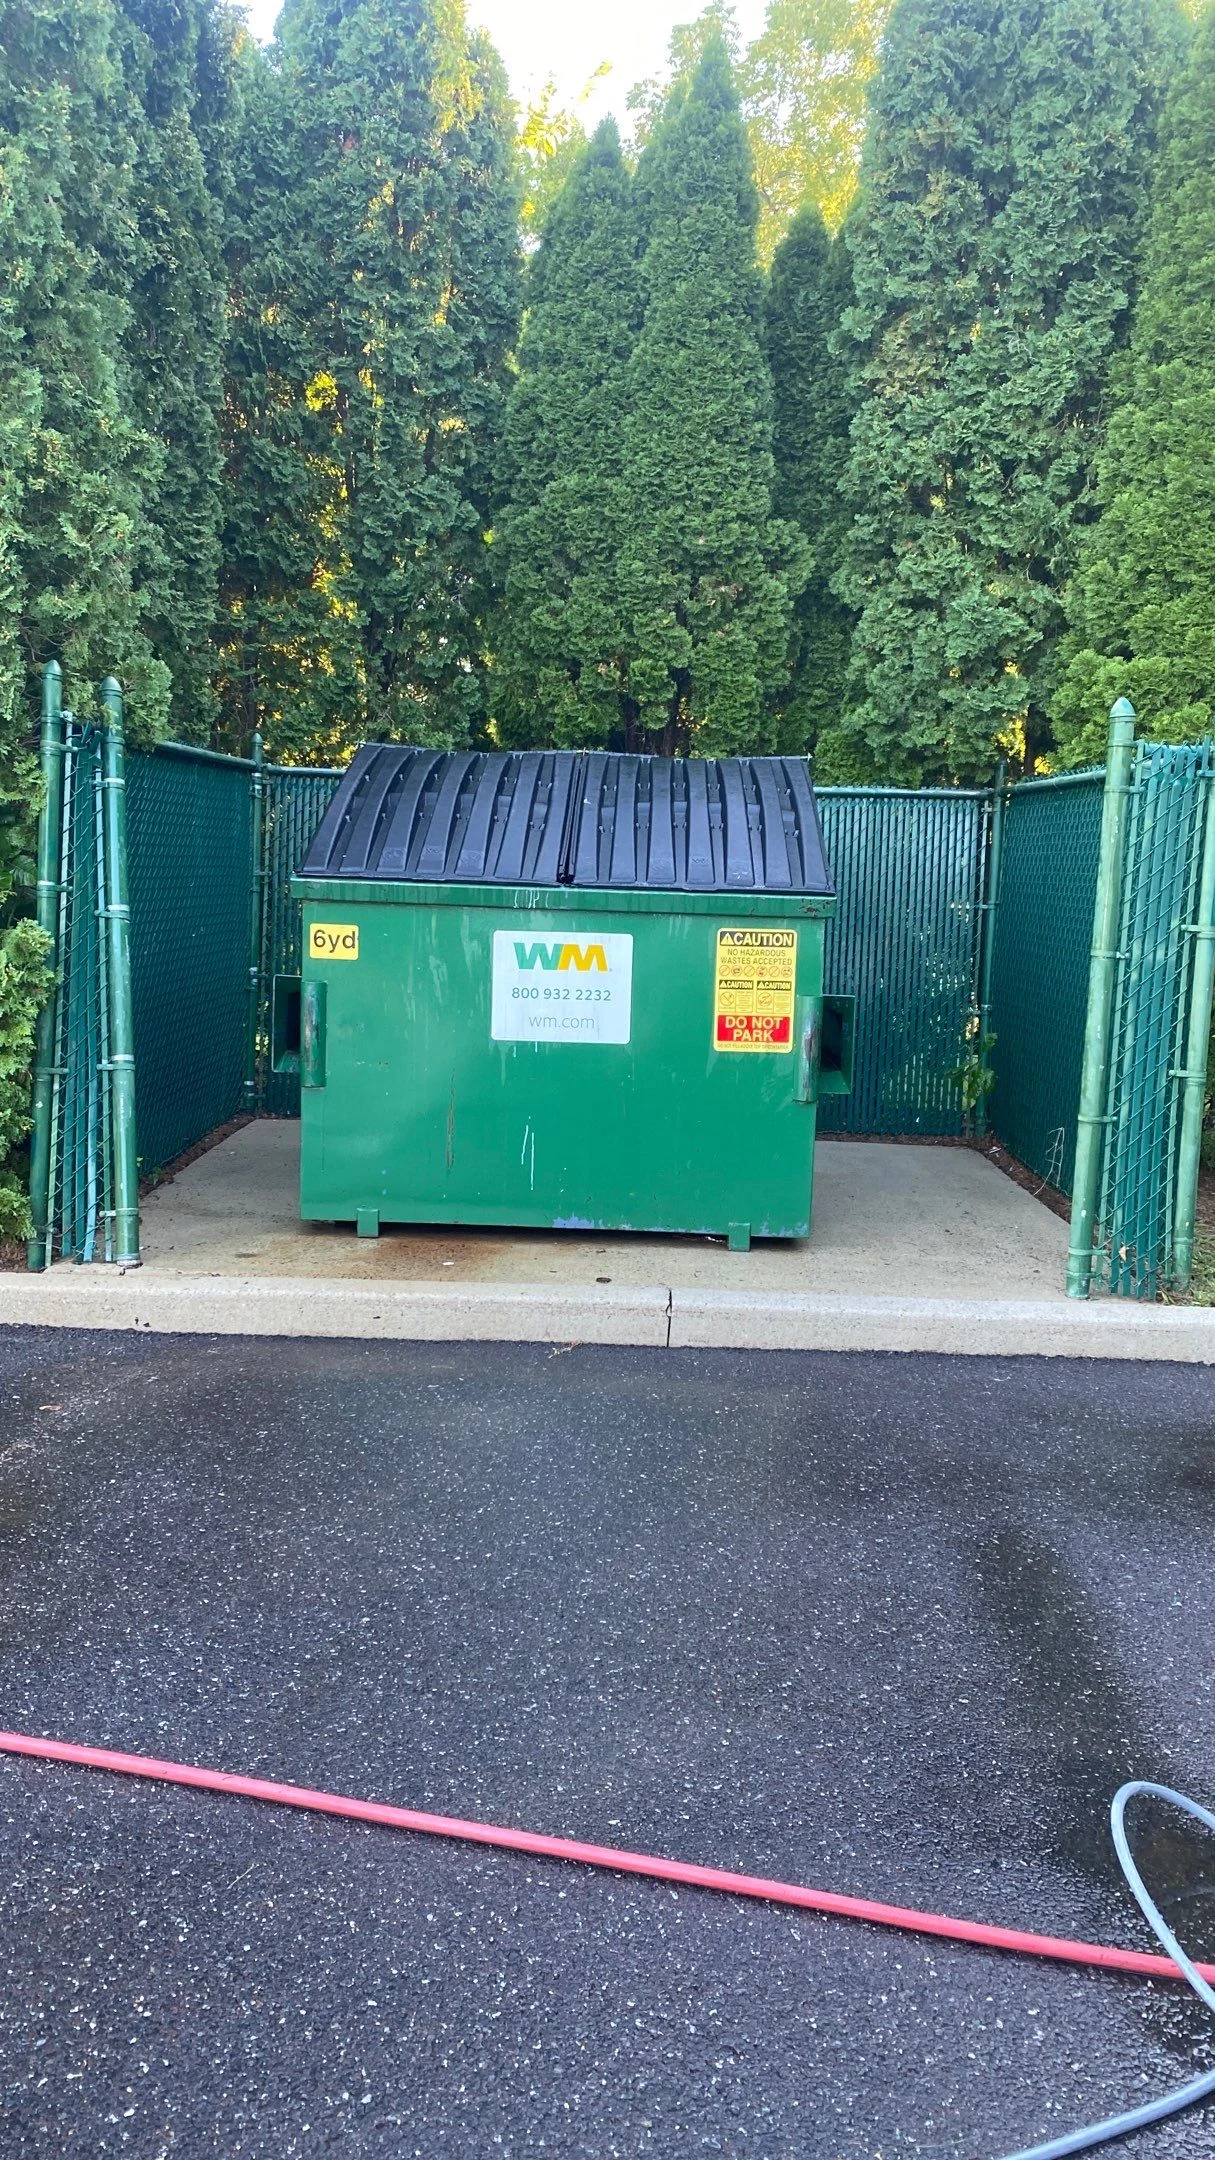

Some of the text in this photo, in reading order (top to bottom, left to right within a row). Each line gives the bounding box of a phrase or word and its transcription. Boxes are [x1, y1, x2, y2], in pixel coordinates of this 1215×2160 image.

[313, 929, 356, 953] 6yd
[733, 932, 793, 947] CAUTION
[513, 942, 609, 972] WM
[727, 948, 786, 957] NO HAZARDOUS
[721, 957, 793, 966] WASTES ACCEPTED
[727, 981, 753, 989] CAUTION
[764, 981, 791, 990] CAUTION
[512, 987, 611, 1001] 800 932 2232
[529, 1016, 595, 1029] wm.com
[725, 1016, 784, 1030] DO NOT
[733, 1029, 774, 1042] PARK
